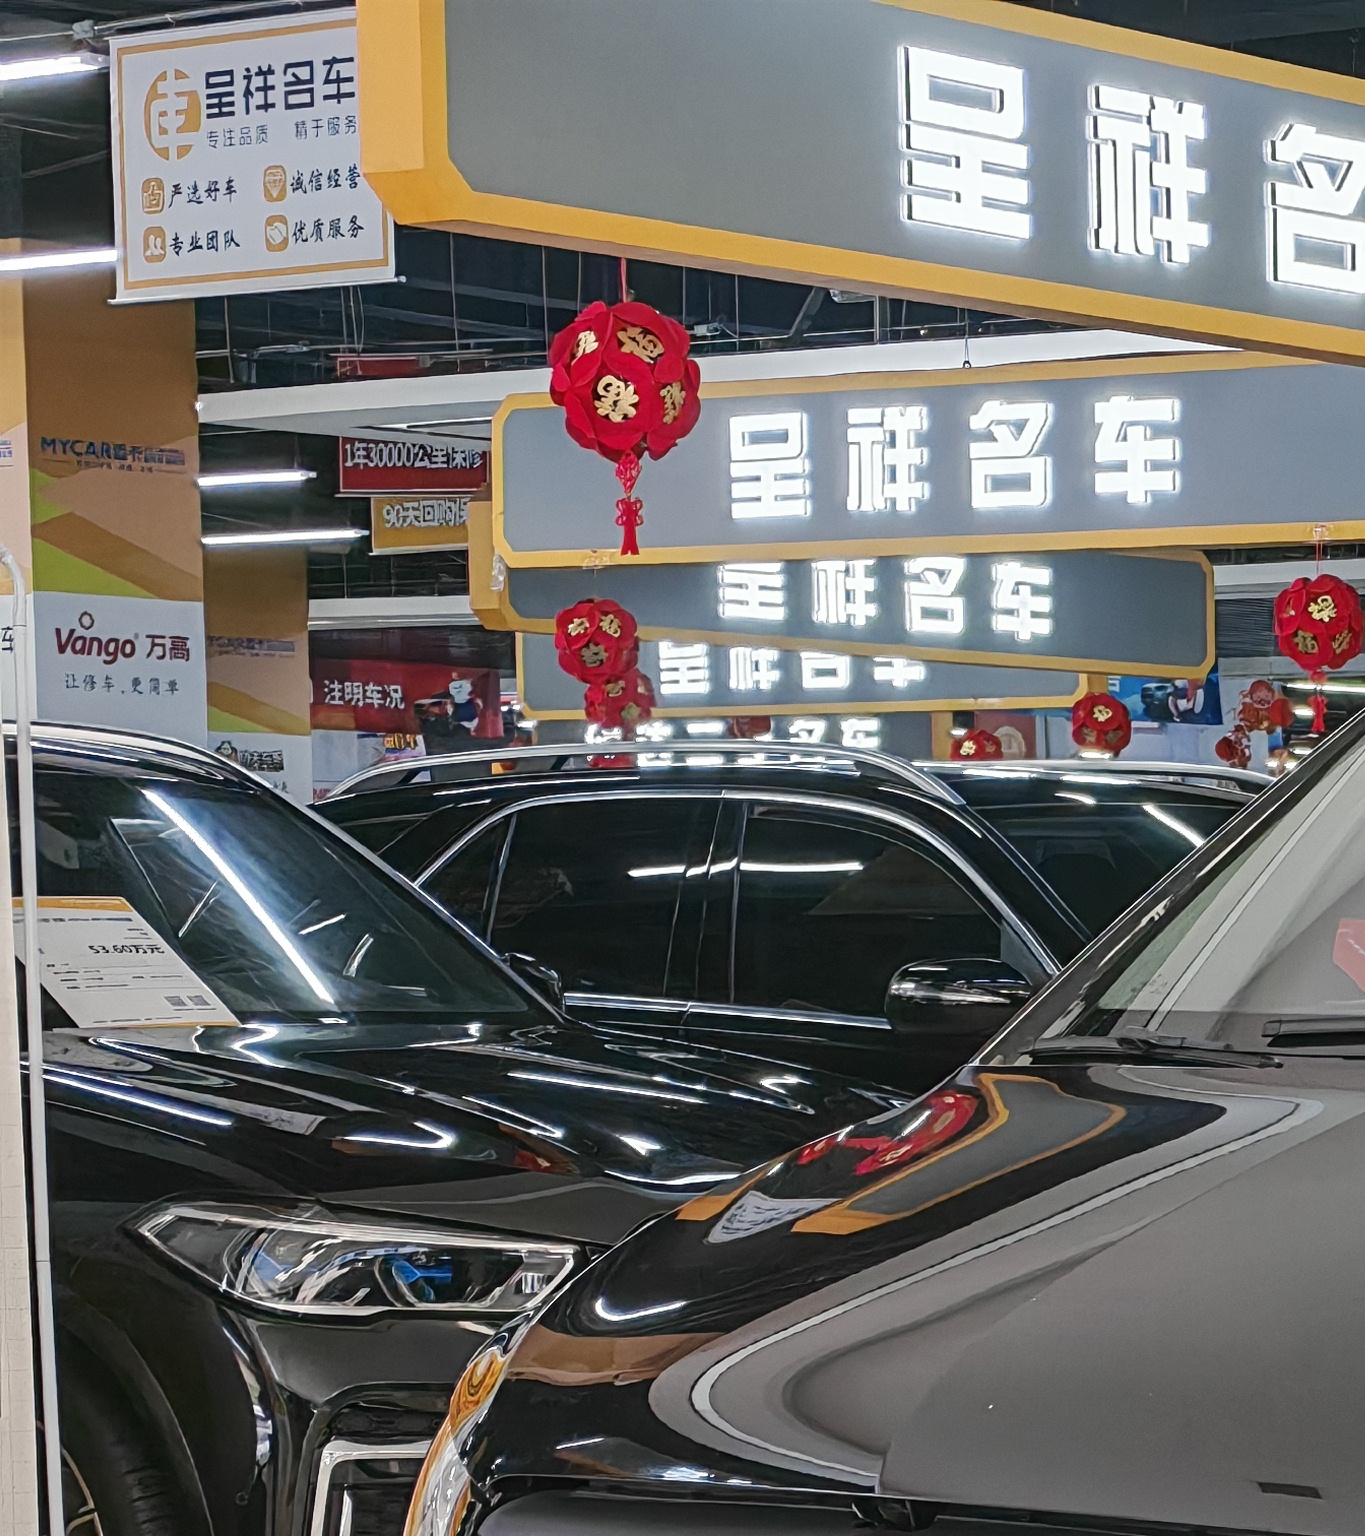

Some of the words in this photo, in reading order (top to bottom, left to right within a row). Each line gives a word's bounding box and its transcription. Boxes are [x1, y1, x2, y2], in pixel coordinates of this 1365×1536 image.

[204, 55, 356, 120] 呈祥名车
[206, 124, 269, 150] 专注品质
[294, 114, 358, 141] 精于服务
[168, 175, 238, 209] 严选好车
[289, 163, 361, 195] 诚信经营
[168, 228, 242, 257] 专业团队
[291, 214, 365, 244] 优质服务
[728, 395, 1183, 521] 呈祥名车
[54, 627, 137, 665] Vango
[145, 634, 190, 663] 万高
[323, 679, 406, 710] 注明车况
